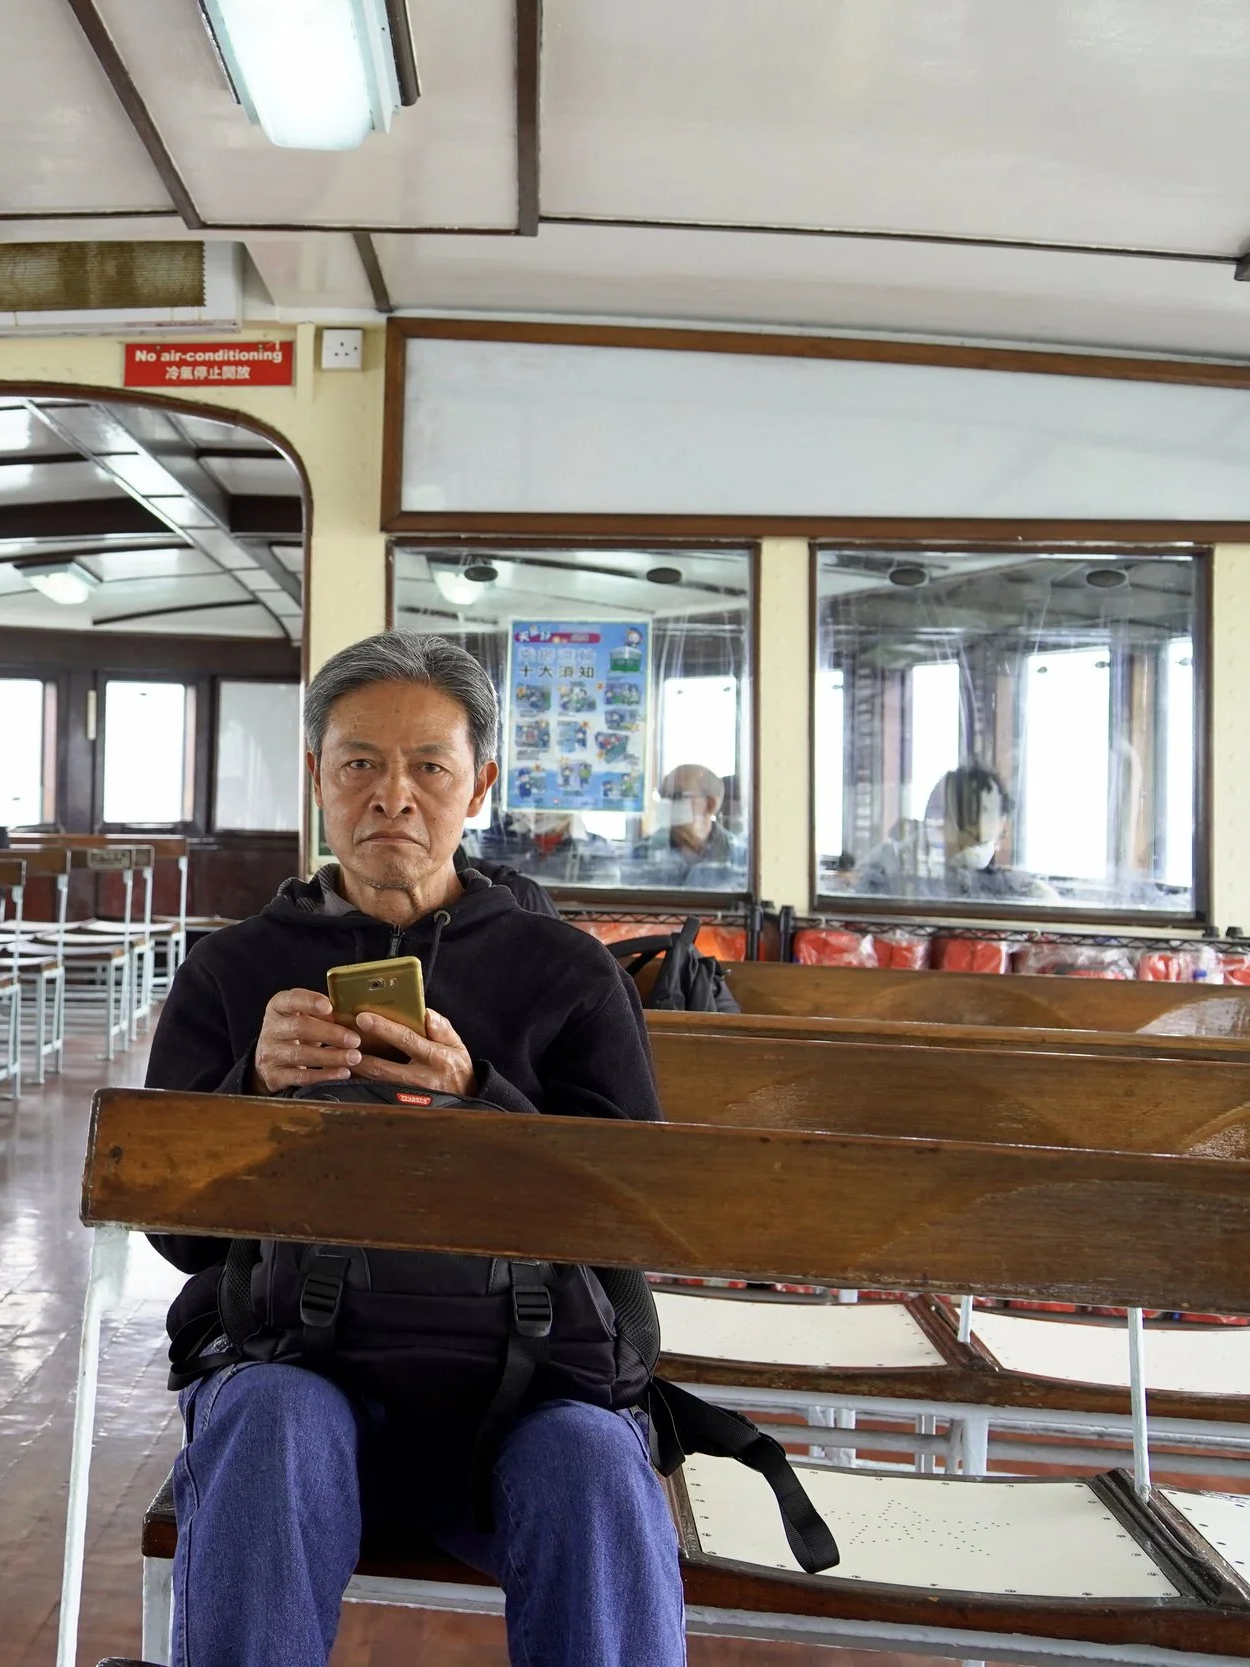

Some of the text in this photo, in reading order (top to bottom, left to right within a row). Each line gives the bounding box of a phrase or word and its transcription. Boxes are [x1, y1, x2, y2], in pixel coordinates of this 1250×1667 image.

[135, 349, 282, 363] No air-conditioning
[165, 365, 251, 380] 冷氣停止開放
[518, 664, 595, 678] 十大須知
